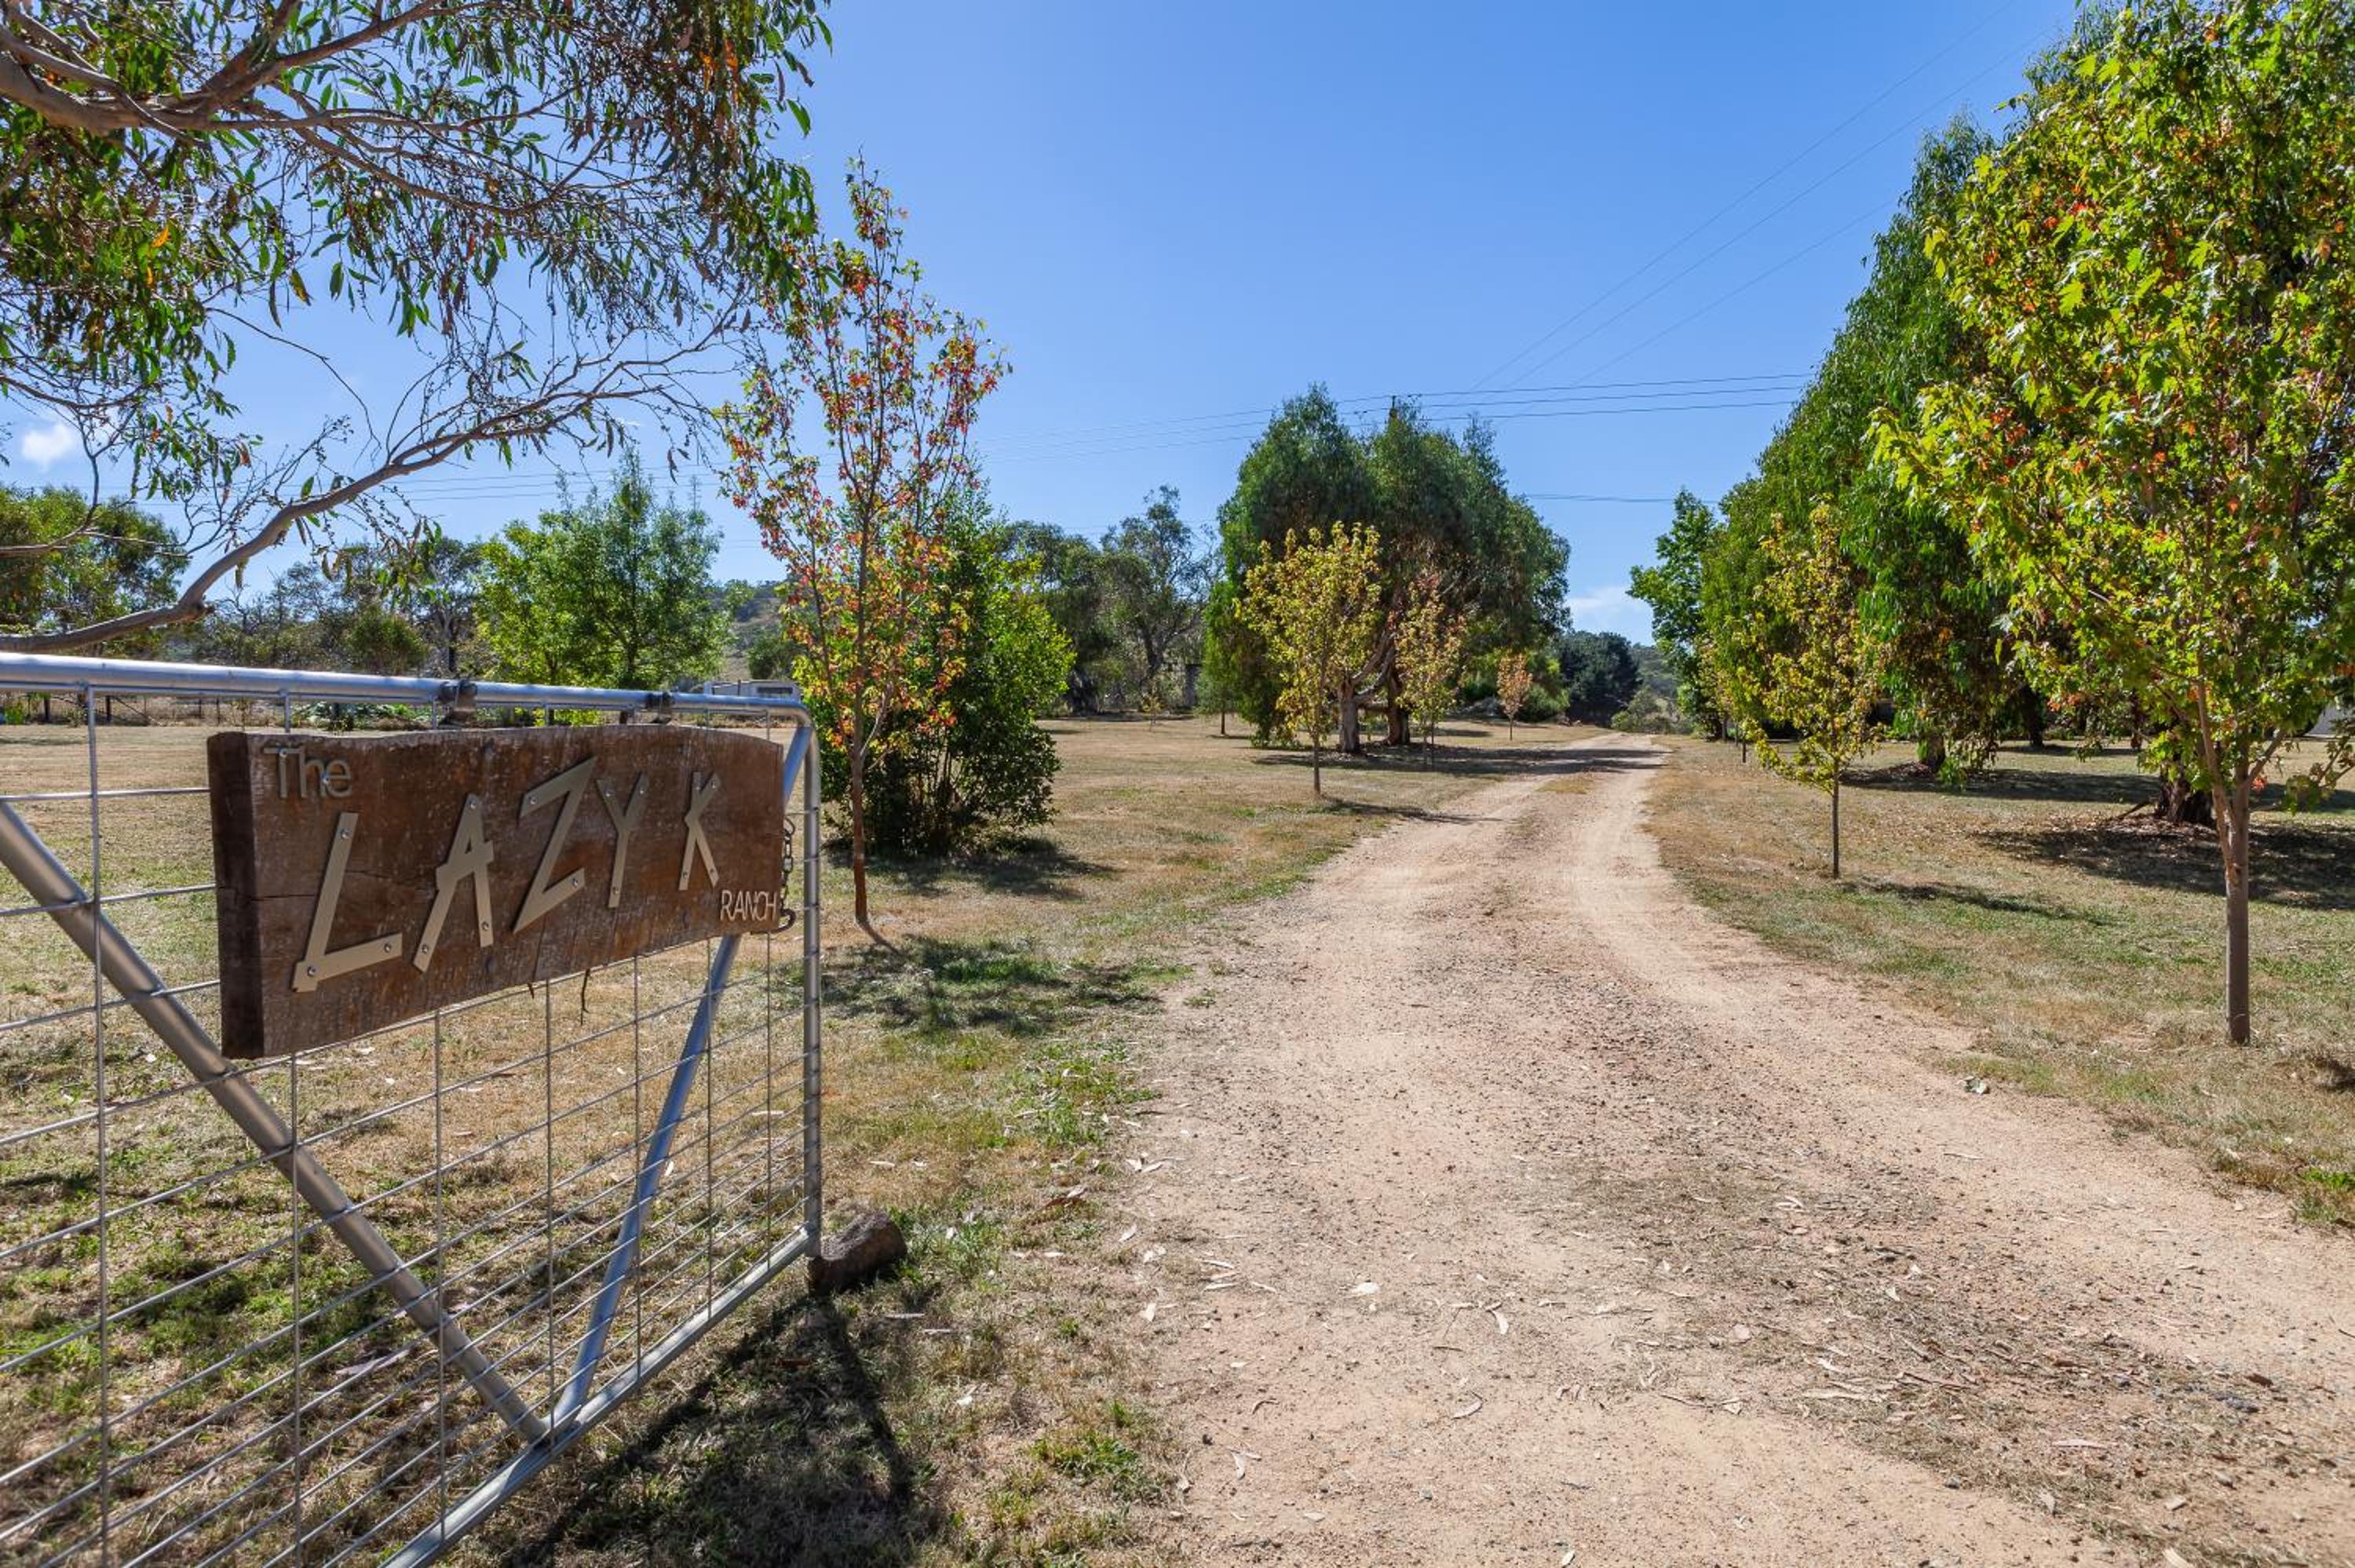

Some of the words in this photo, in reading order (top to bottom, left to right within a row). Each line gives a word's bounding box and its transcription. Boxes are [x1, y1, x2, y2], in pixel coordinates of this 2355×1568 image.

[262, 748, 353, 800] The
[292, 756, 649, 993] LAZY
[678, 771, 721, 891] K
[720, 889, 777, 921] RANCH
